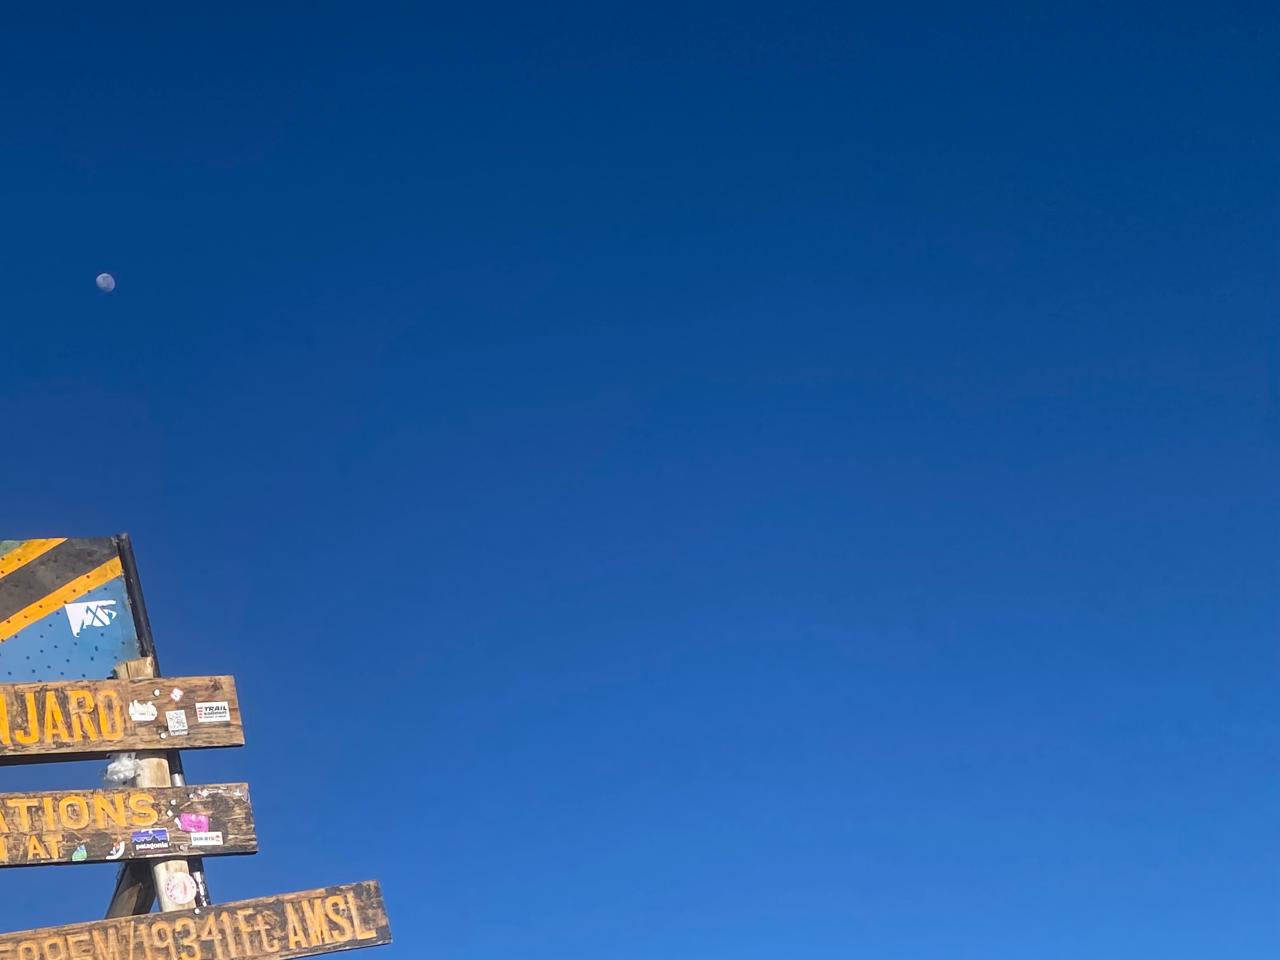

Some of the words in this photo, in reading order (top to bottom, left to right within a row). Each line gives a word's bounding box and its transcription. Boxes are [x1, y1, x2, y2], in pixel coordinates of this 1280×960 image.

[26, 834, 64, 859] AT
[135, 841, 169, 851] patagonia
[285, 890, 378, 950] AMSL
